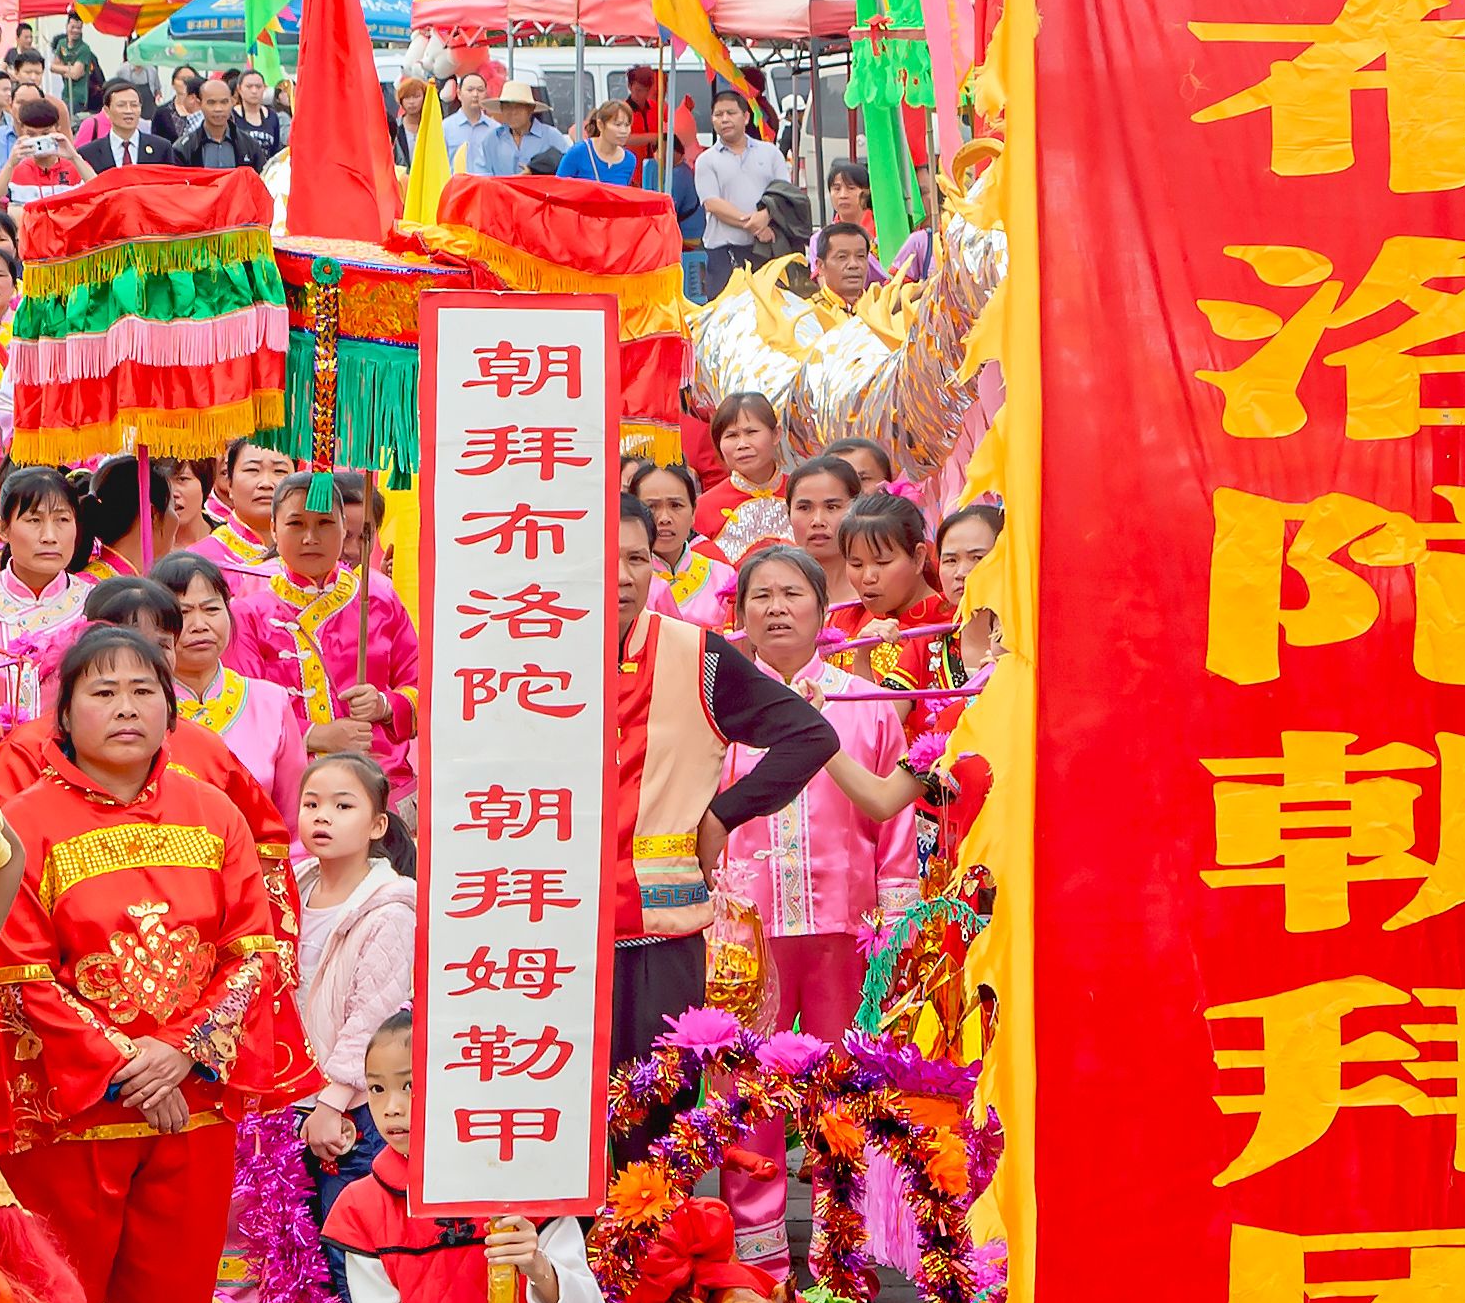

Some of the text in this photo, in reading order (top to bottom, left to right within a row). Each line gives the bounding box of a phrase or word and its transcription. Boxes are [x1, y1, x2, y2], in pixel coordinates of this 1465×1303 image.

[442, 340, 593, 1163] 朝拜布洛陀 朝拜姆勒甲
